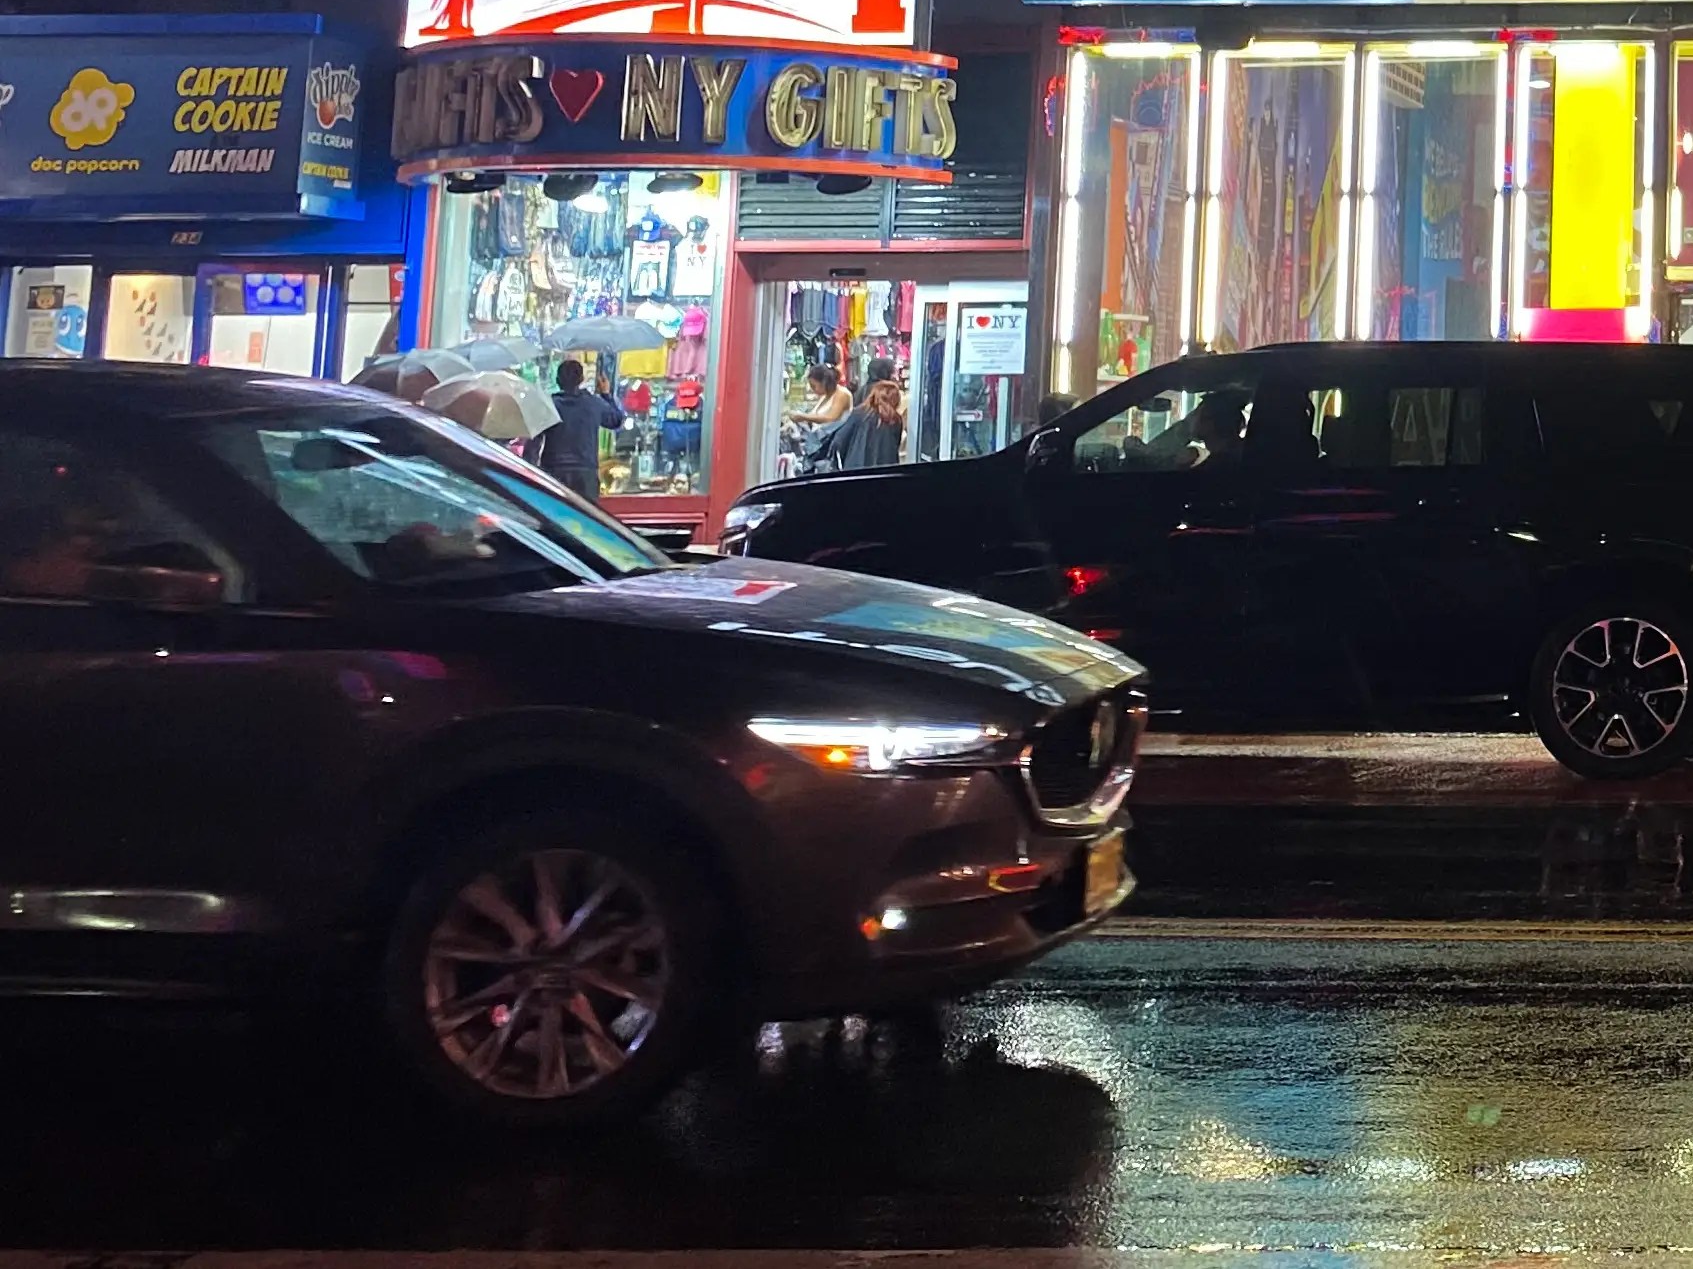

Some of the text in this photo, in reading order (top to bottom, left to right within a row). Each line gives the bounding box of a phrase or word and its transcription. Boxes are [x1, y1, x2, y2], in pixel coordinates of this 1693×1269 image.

[176, 66, 288, 98] CAPTAIN
[173, 99, 282, 133] COOKIE
[765, 62, 957, 160] GIFTS
[323, 133, 354, 149] CREAM
[31, 155, 140, 175] doc popcorn
[169, 148, 276, 174] MILKMAN
[966, 315, 1022, 329] I NY
